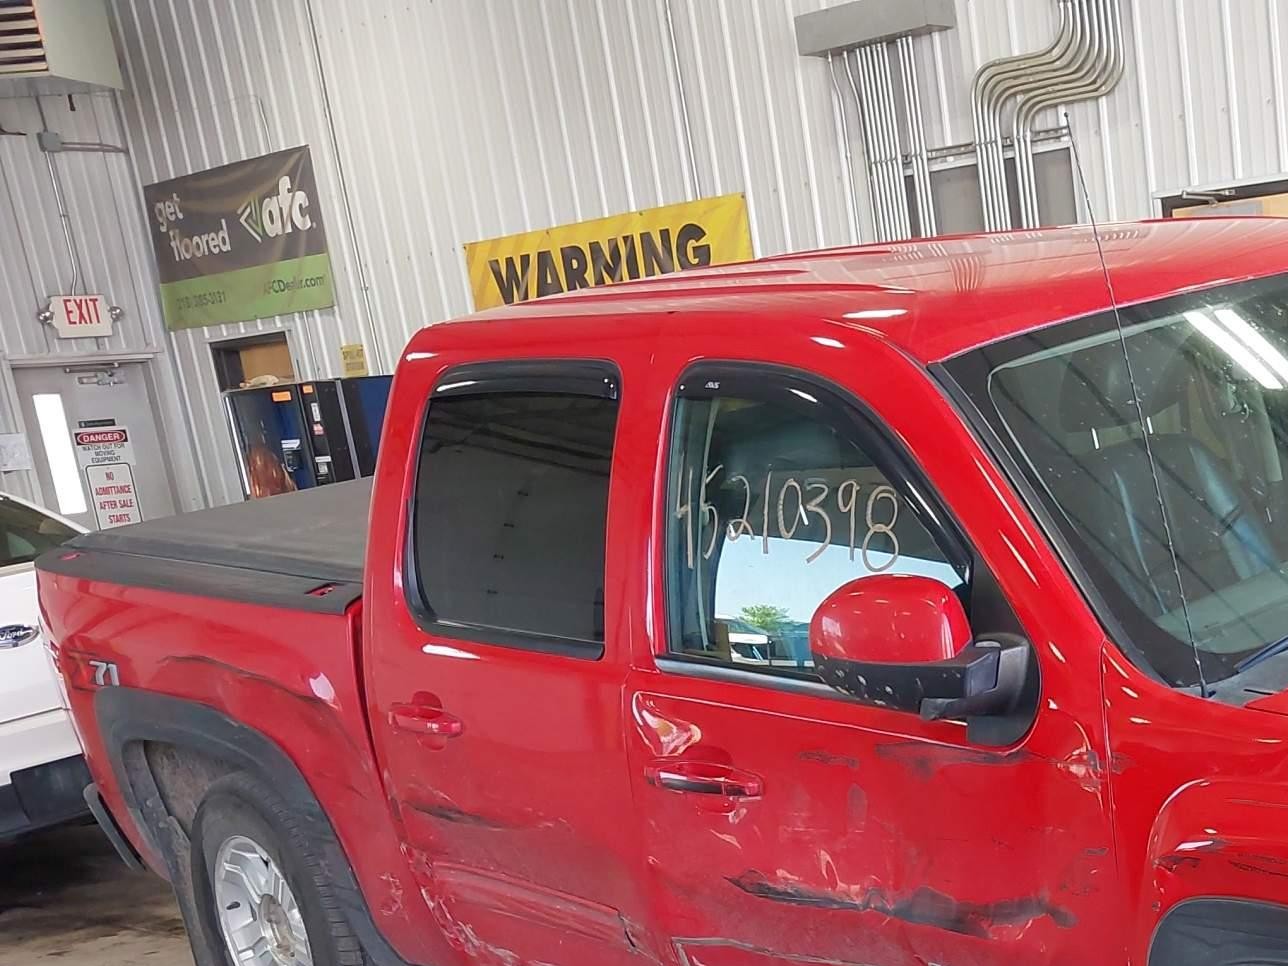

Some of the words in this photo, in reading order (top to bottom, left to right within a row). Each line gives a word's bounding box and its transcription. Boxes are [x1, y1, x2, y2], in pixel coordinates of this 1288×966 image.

[155, 193, 184, 233] get
[261, 175, 312, 237] afc
[169, 219, 231, 262] floored
[488, 223, 712, 305] WARNING
[63, 298, 101, 325] EXIT
[83, 433, 120, 443] DANGER
[91, 456, 121, 464] EQUIPMENT
[105, 472, 114, 481] NO
[95, 485, 132, 495] ADMITTANCE
[99, 500, 118, 510] AFTER
[120, 499, 134, 508] SALE
[675, 455, 900, 573] 45210398
[108, 513, 131, 524] STARTS
